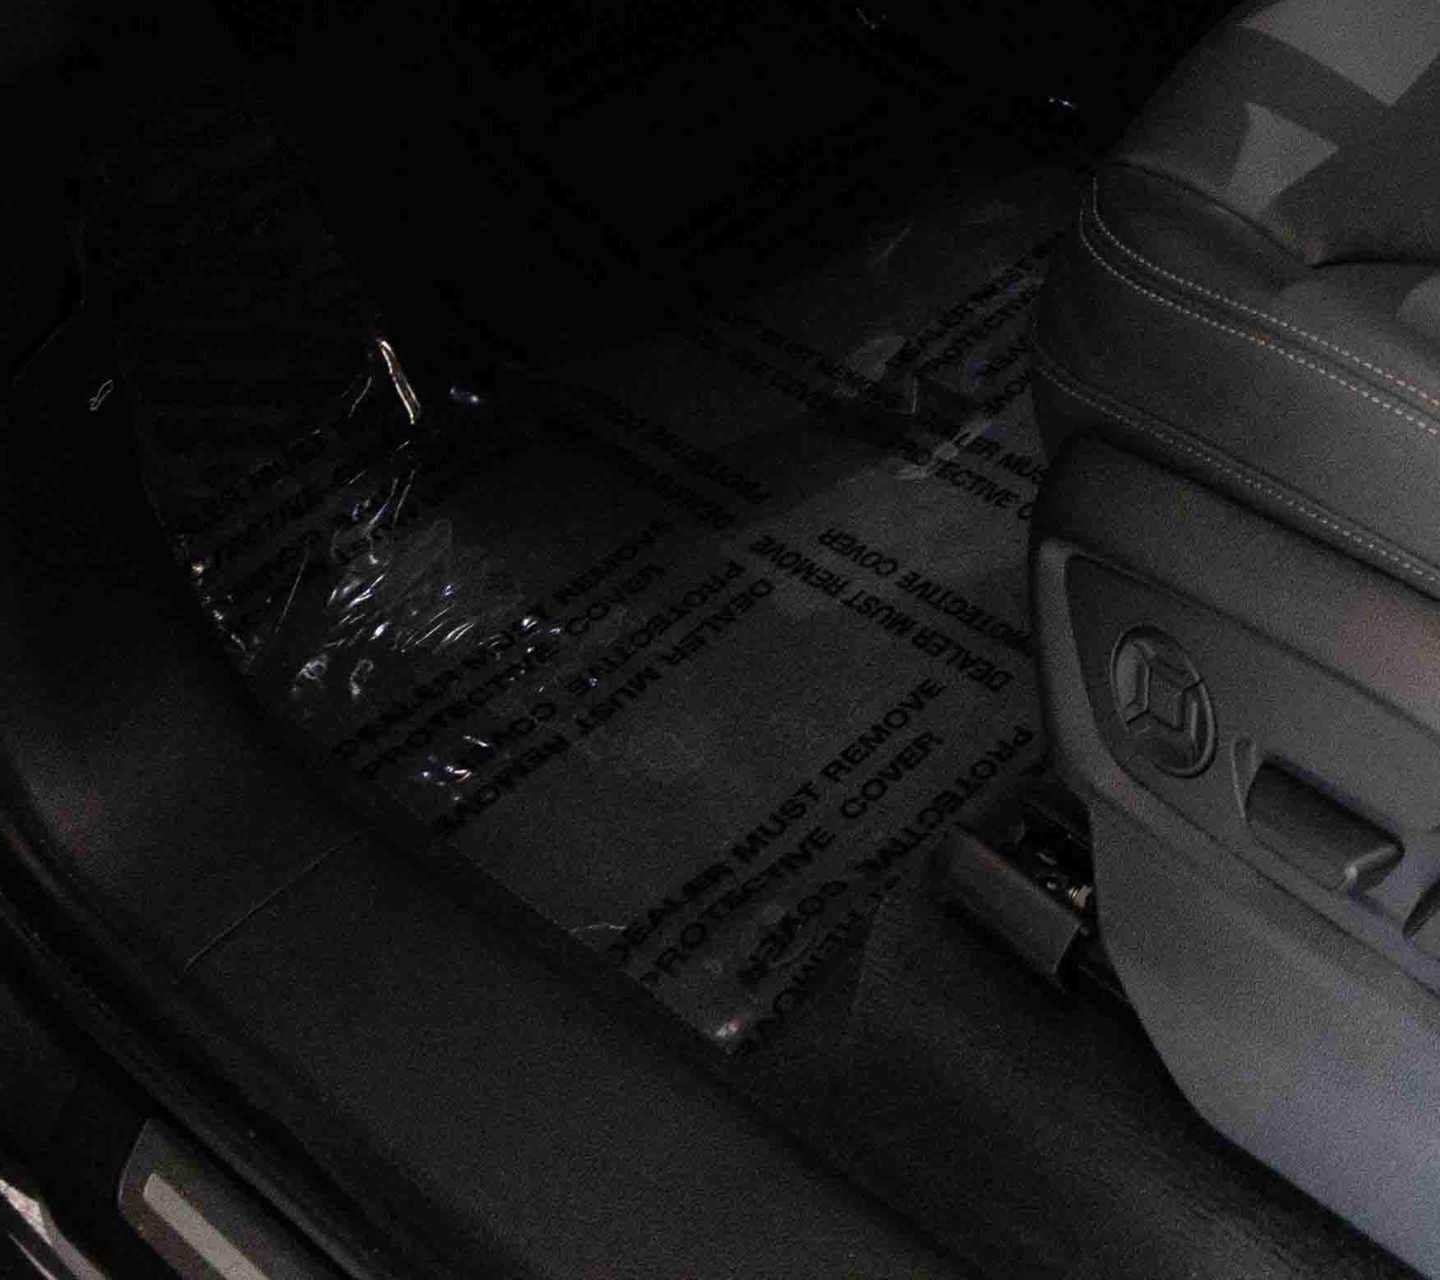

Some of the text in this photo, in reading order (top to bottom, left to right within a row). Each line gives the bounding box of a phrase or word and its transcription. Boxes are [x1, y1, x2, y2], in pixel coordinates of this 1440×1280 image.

[819, 529, 899, 578] COVER
[750, 534, 1011, 694] DEALER MUST REMOVE
[576, 667, 661, 735] MUST
[730, 781, 824, 864] MUST
[820, 678, 947, 783] REMOVE
[839, 729, 945, 821] COVER
